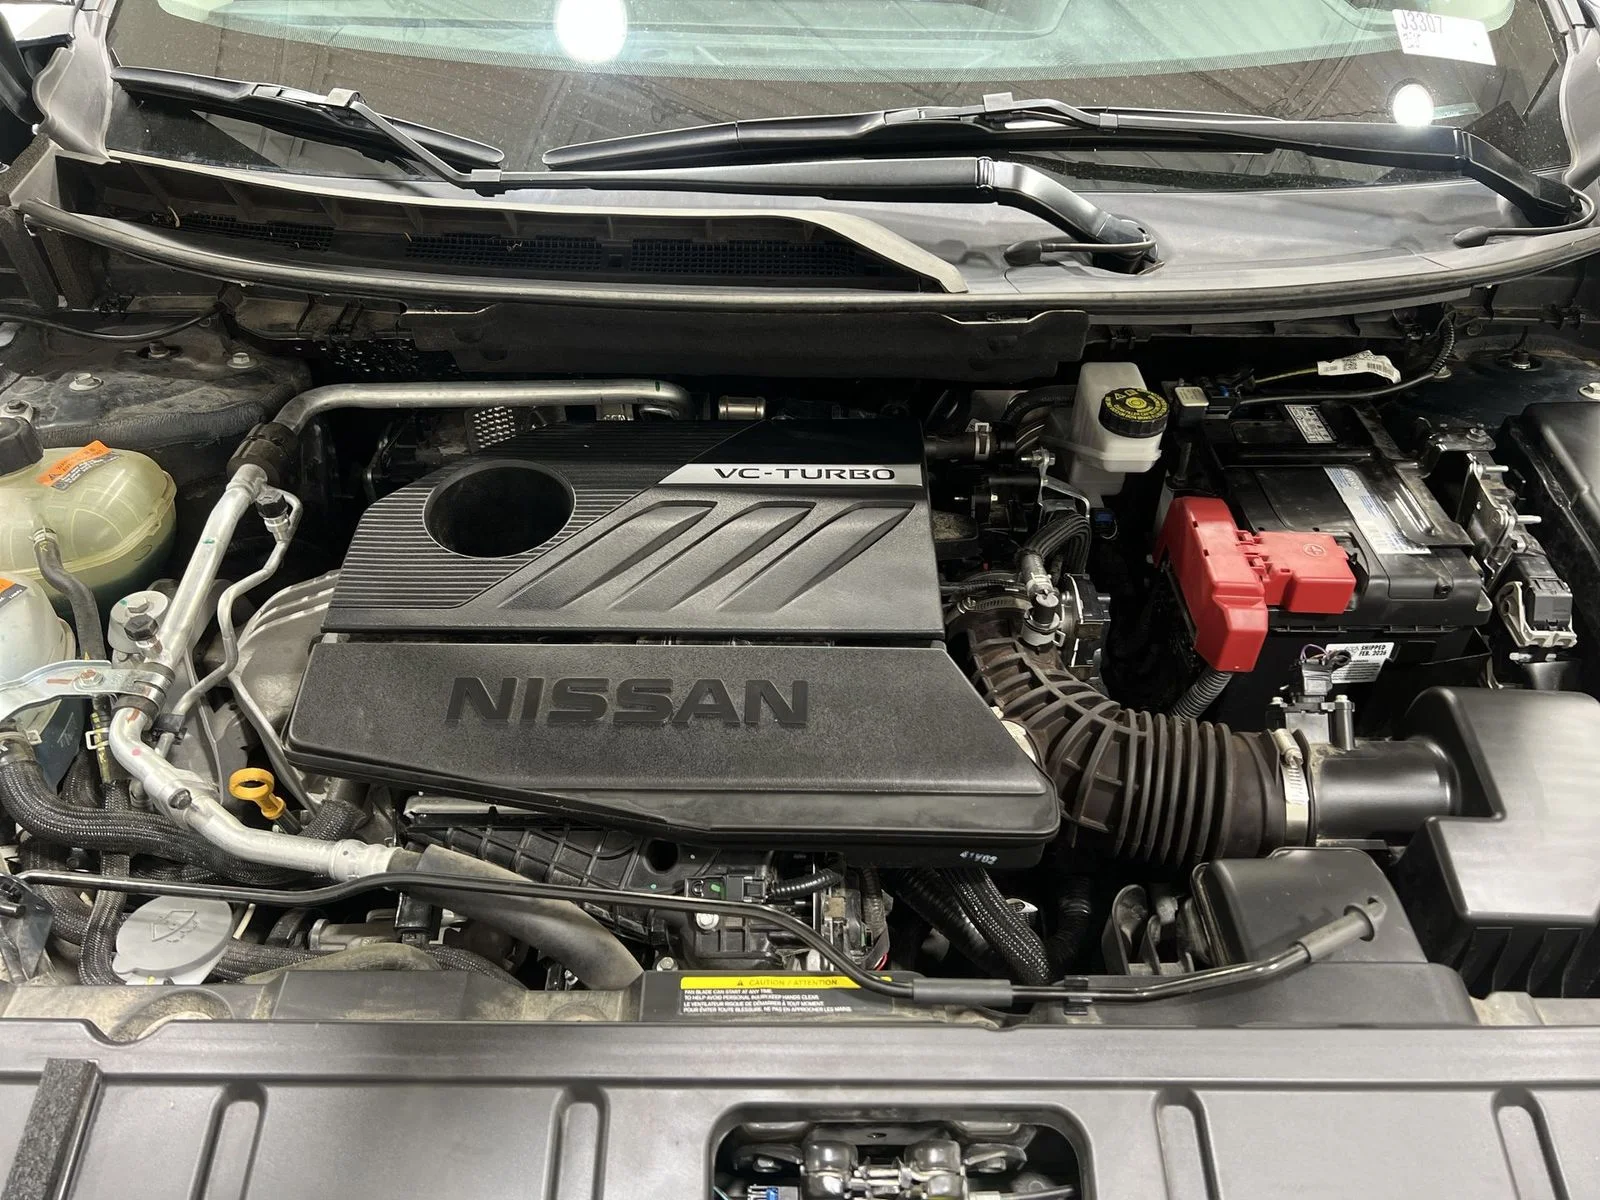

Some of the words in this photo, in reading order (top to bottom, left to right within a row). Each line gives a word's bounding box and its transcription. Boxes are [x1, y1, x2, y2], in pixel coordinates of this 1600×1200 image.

[1401, 10, 1442, 34] J3307
[714, 468, 895, 480] VC-TURBO
[446, 677, 809, 726] NISSAN
